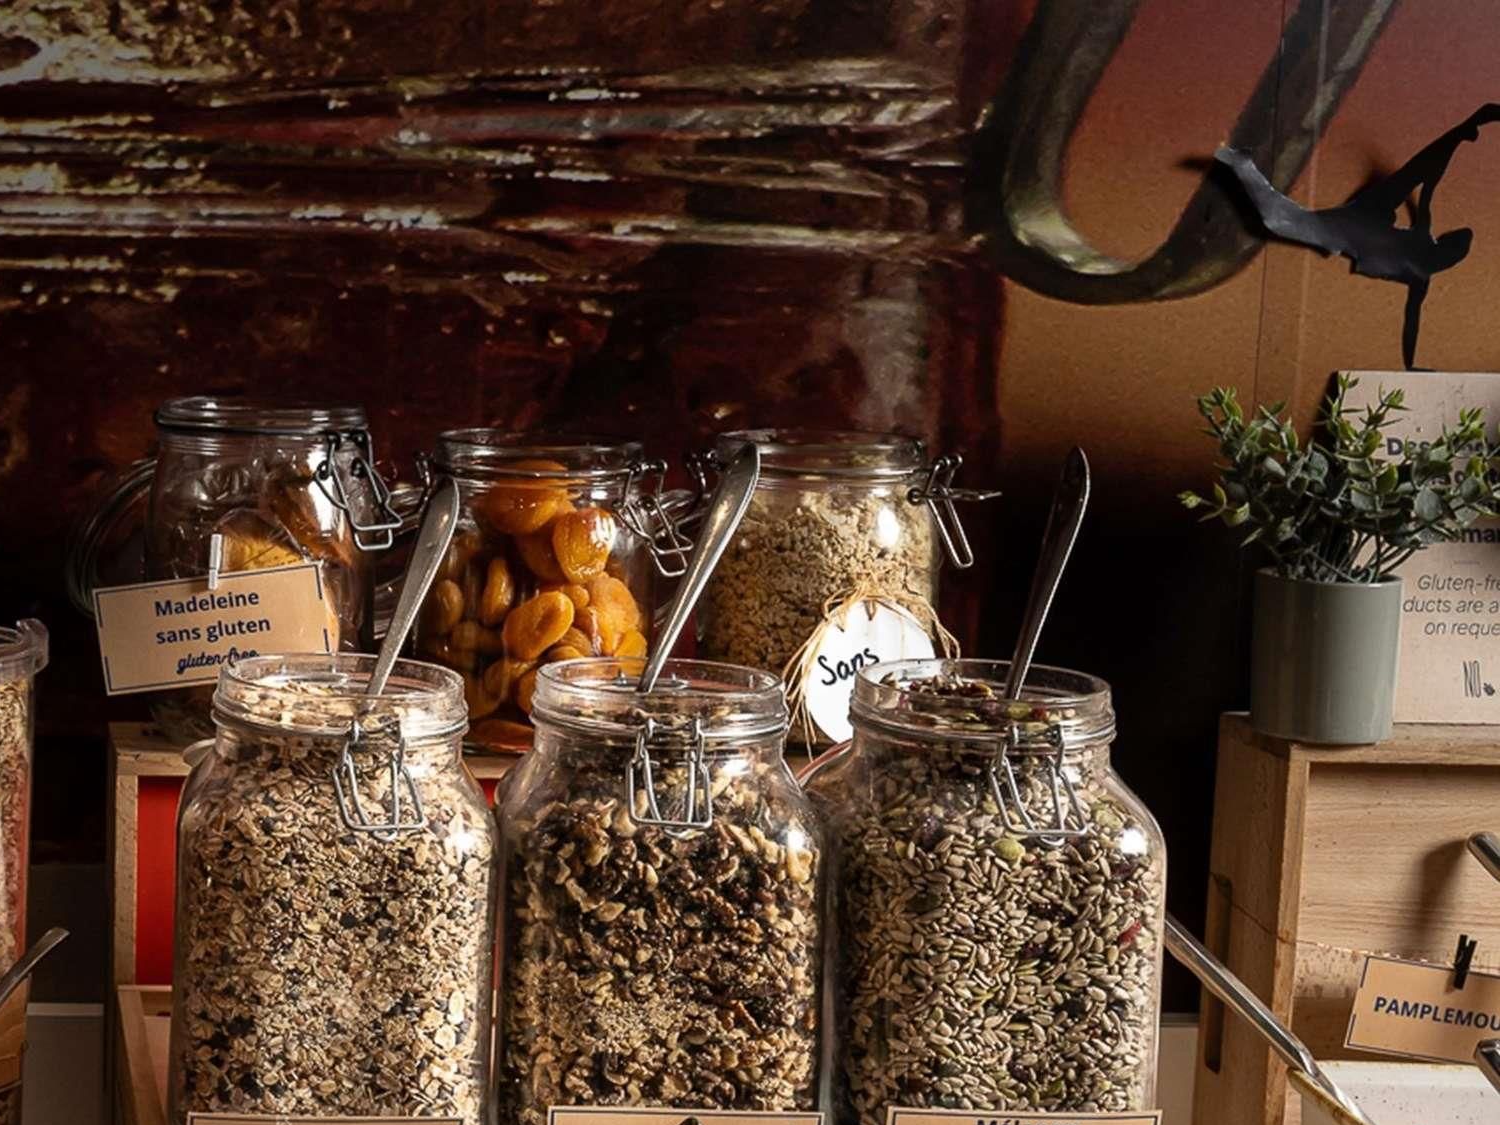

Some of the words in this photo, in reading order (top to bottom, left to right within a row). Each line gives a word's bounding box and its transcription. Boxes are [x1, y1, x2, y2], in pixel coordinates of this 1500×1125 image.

[155, 591, 260, 617] Madeleine
[1402, 596, 1451, 613] ducts
[1456, 599, 1484, 613] are
[156, 626, 201, 645] sans
[206, 618, 271, 643] gluten
[1424, 622, 1446, 636] on
[817, 648, 880, 685] Sans
[1374, 997, 1500, 1032] PAMPLEMOU
